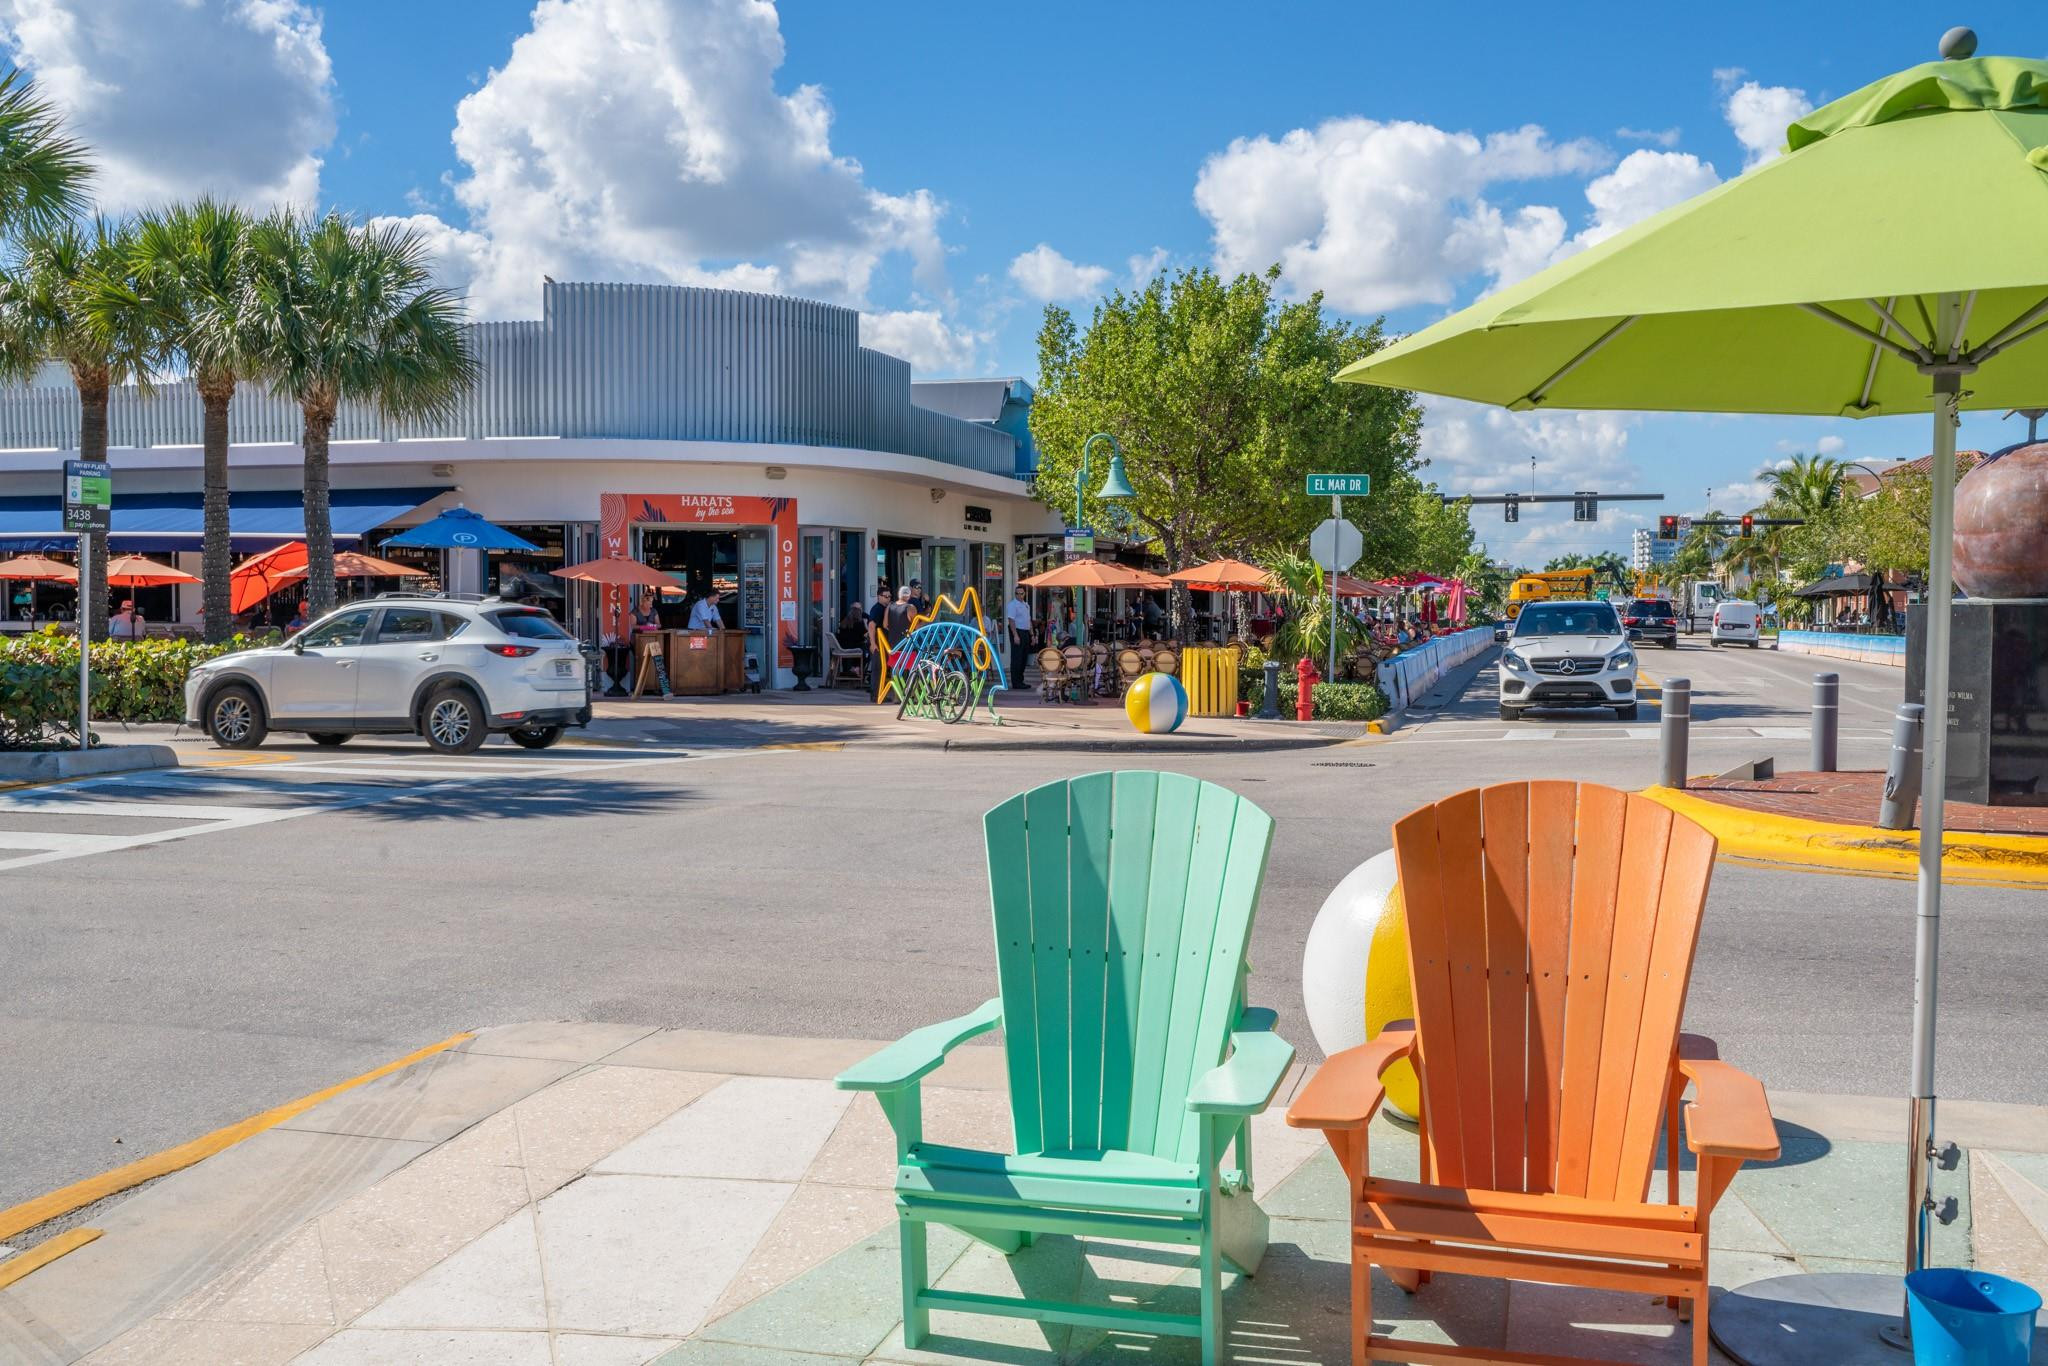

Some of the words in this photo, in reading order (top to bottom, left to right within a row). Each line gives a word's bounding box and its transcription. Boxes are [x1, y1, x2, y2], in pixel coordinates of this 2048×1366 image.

[73, 462, 107, 471] PAY-BY-PLATE
[1314, 478, 1325, 491] EL
[1328, 478, 1346, 491] MAR
[1349, 479, 1361, 491] DR
[67, 509, 91, 520] 3438
[695, 507, 706, 522] by
[708, 506, 720, 517] the
[721, 507, 735, 515] sea
[782, 539, 793, 599] OPEN
